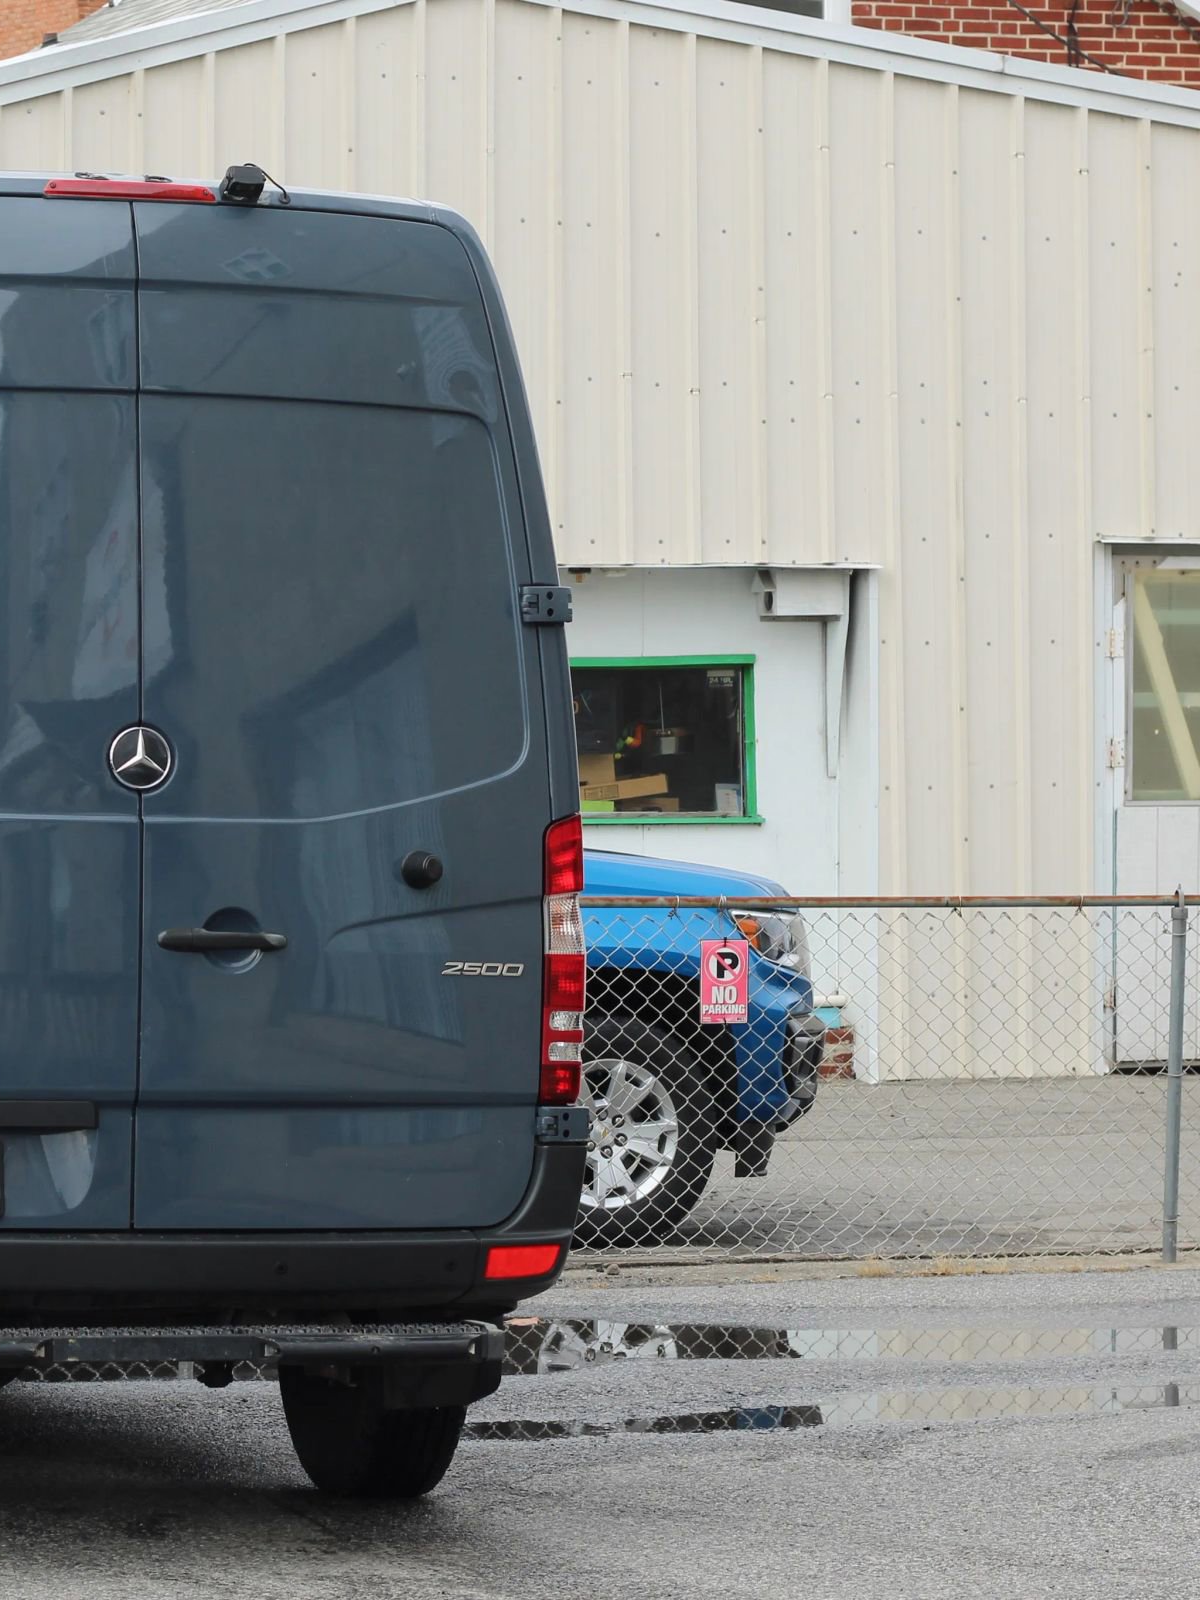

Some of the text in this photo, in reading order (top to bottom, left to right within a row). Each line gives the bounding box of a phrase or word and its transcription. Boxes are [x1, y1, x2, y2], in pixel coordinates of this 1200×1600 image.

[441, 961, 525, 977] 2500
[711, 985, 738, 1004] NO
[702, 1004, 746, 1016] PARKING
